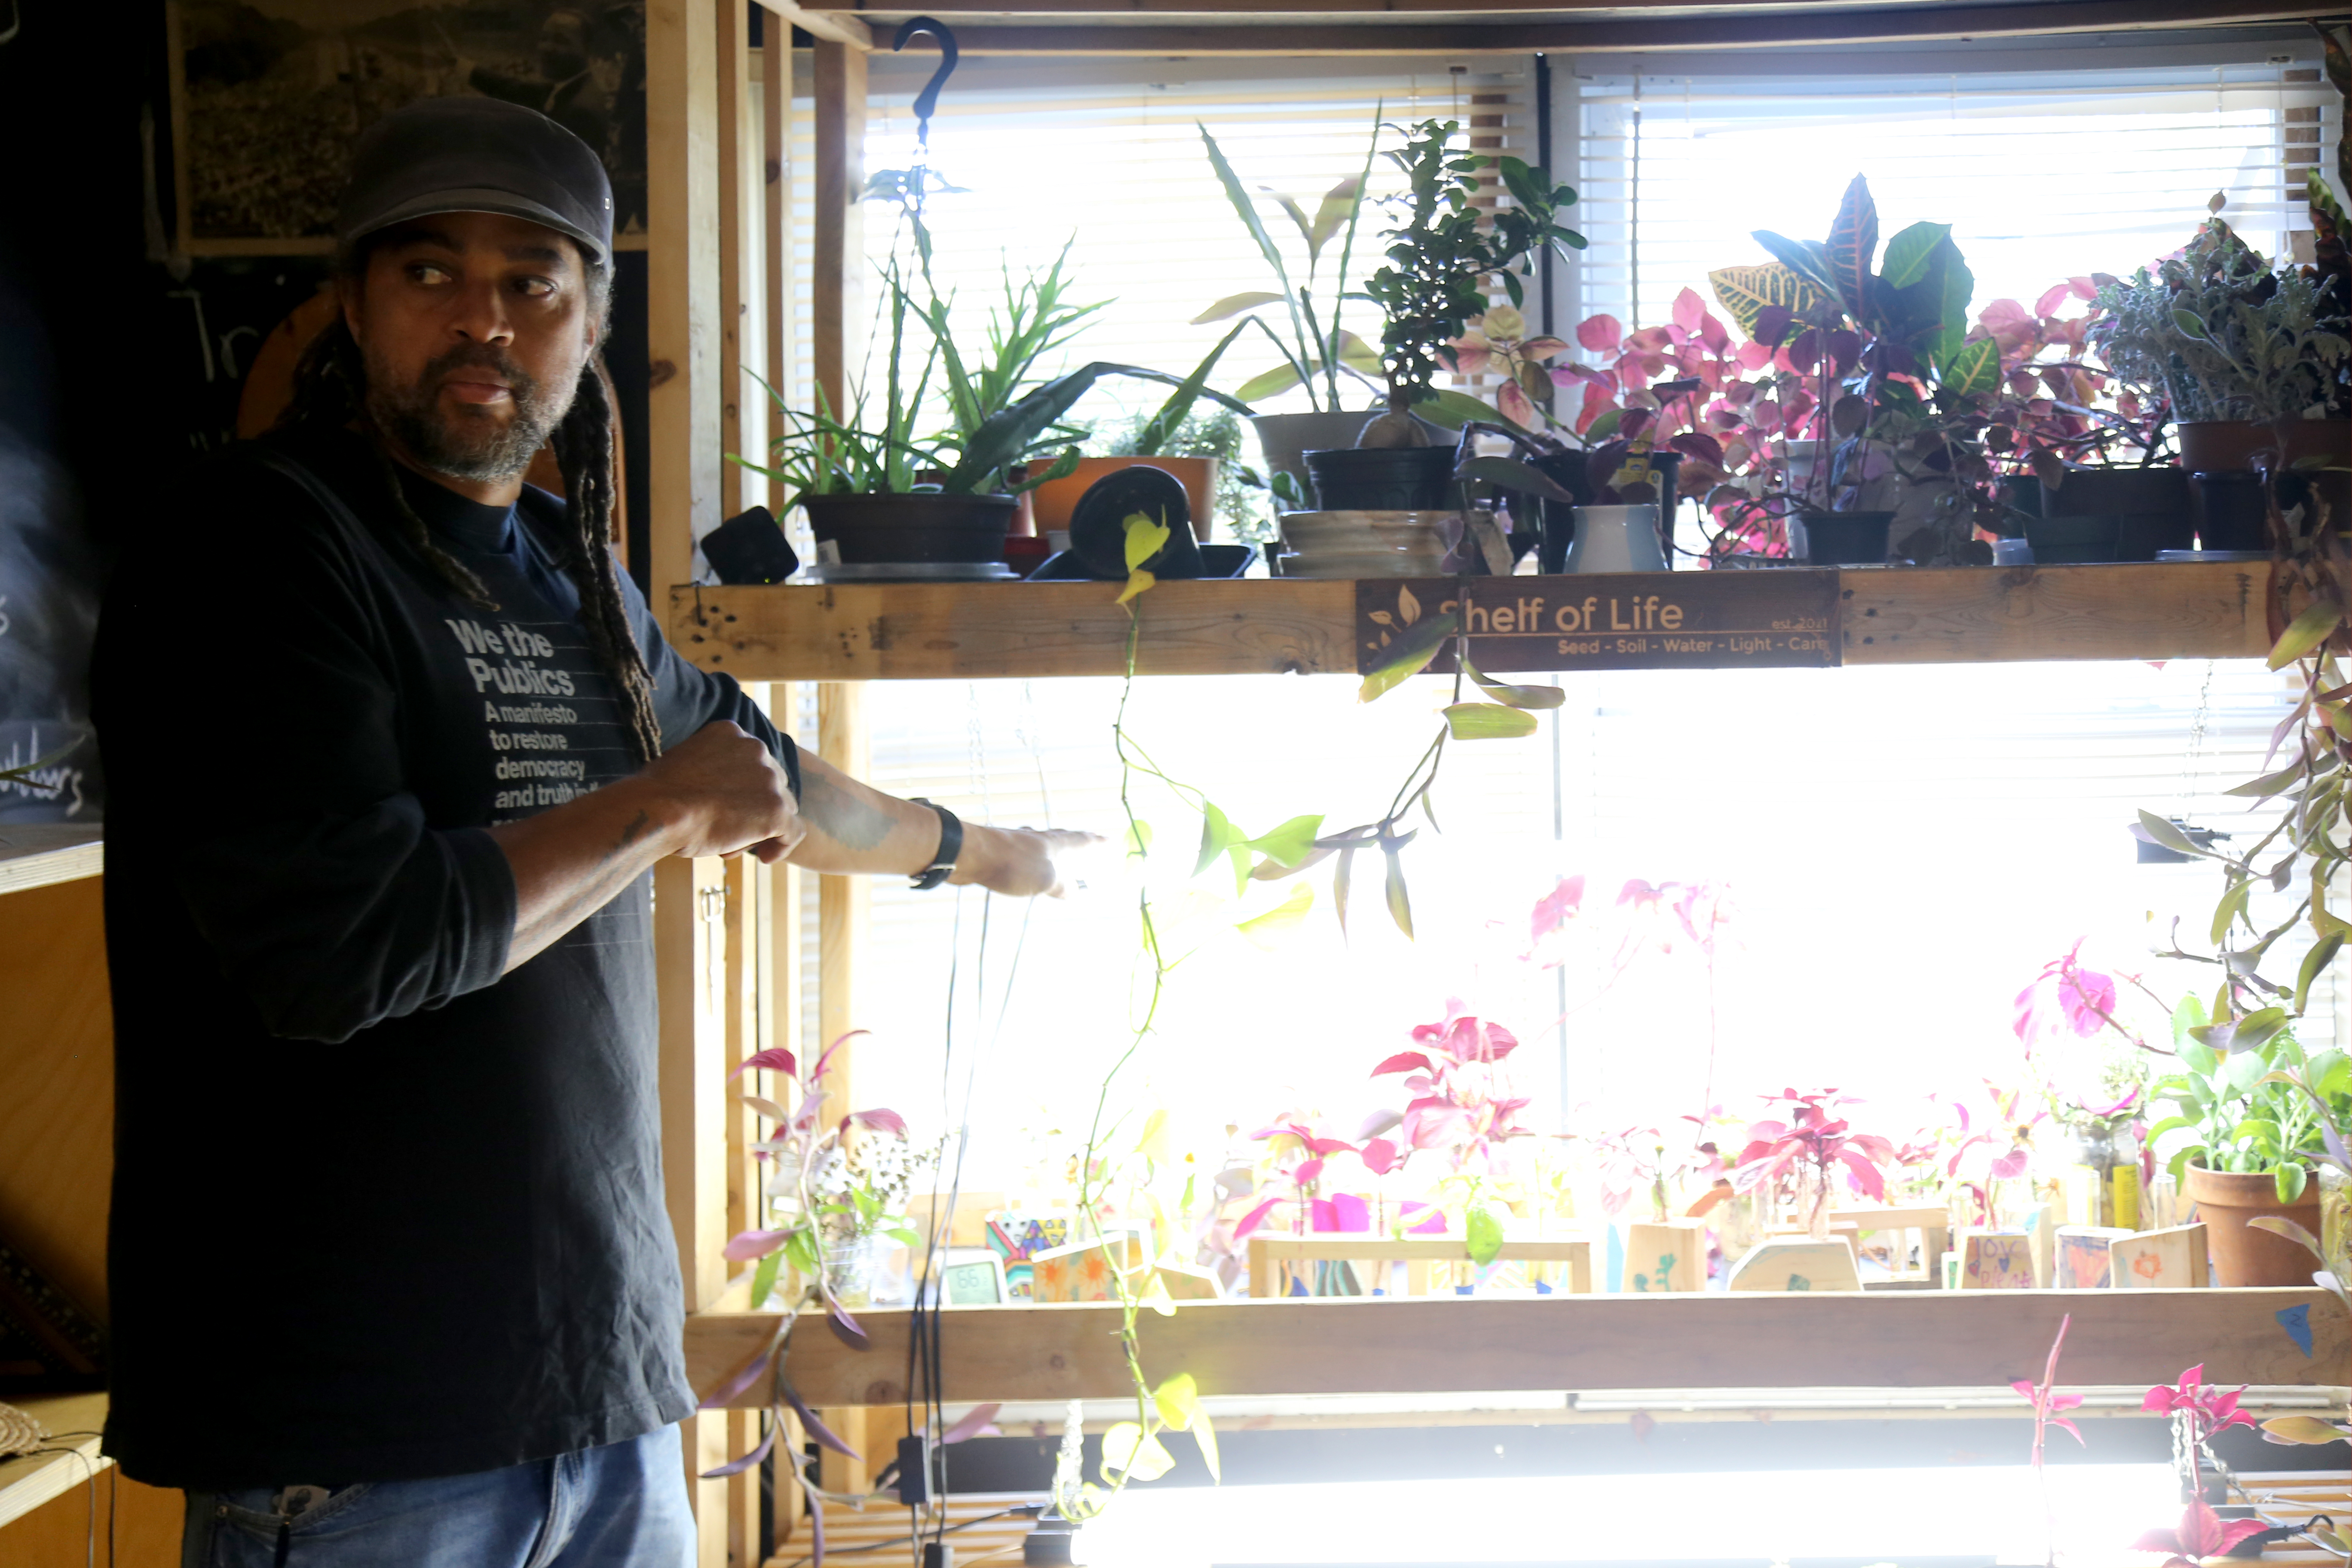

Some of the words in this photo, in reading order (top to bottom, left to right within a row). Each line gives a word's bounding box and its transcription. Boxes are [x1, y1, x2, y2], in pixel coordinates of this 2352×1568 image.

[1556, 597, 1598, 631] of
[1611, 596, 1684, 630] Life
[444, 619, 505, 654] We
[499, 623, 554, 658] the
[1558, 640, 1600, 655] Seed
[1617, 639, 1647, 653] Soil
[1663, 639, 1713, 652] Water
[1730, 637, 1772, 655] Light
[1788, 637, 1828, 650] Care
[465, 657, 575, 696] Publics
[485, 700, 500, 723] A
[501, 702, 578, 724] manifesto
[489, 730, 511, 750] to
[513, 730, 568, 750] restore
[495, 756, 585, 781] democracy
[495, 783, 535, 808] and
[536, 782, 575, 805] truth
